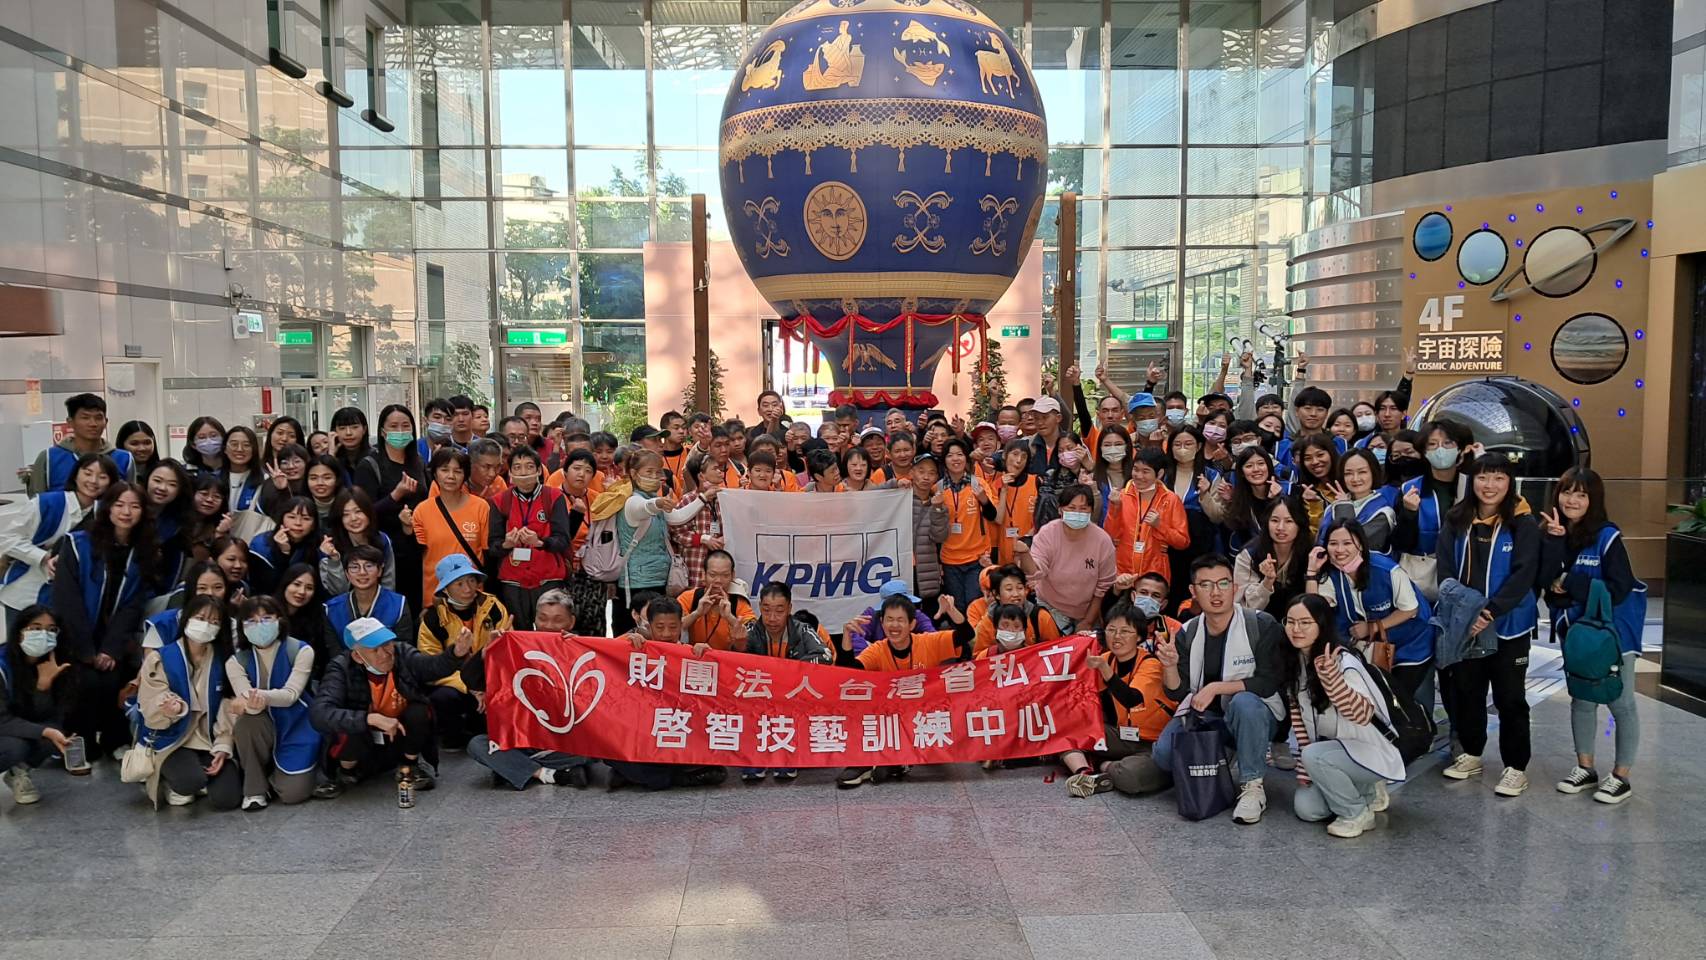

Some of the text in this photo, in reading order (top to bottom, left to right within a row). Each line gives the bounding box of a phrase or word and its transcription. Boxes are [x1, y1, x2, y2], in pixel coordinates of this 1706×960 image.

[1419, 295, 1464, 331] 4F
[1418, 336, 1502, 359] 宇宙探險
[1418, 361, 1502, 370] COSMIC ADVENTURE
[750, 556, 893, 598] KPMG
[627, 645, 1076, 701] 財團法人台灣省私立
